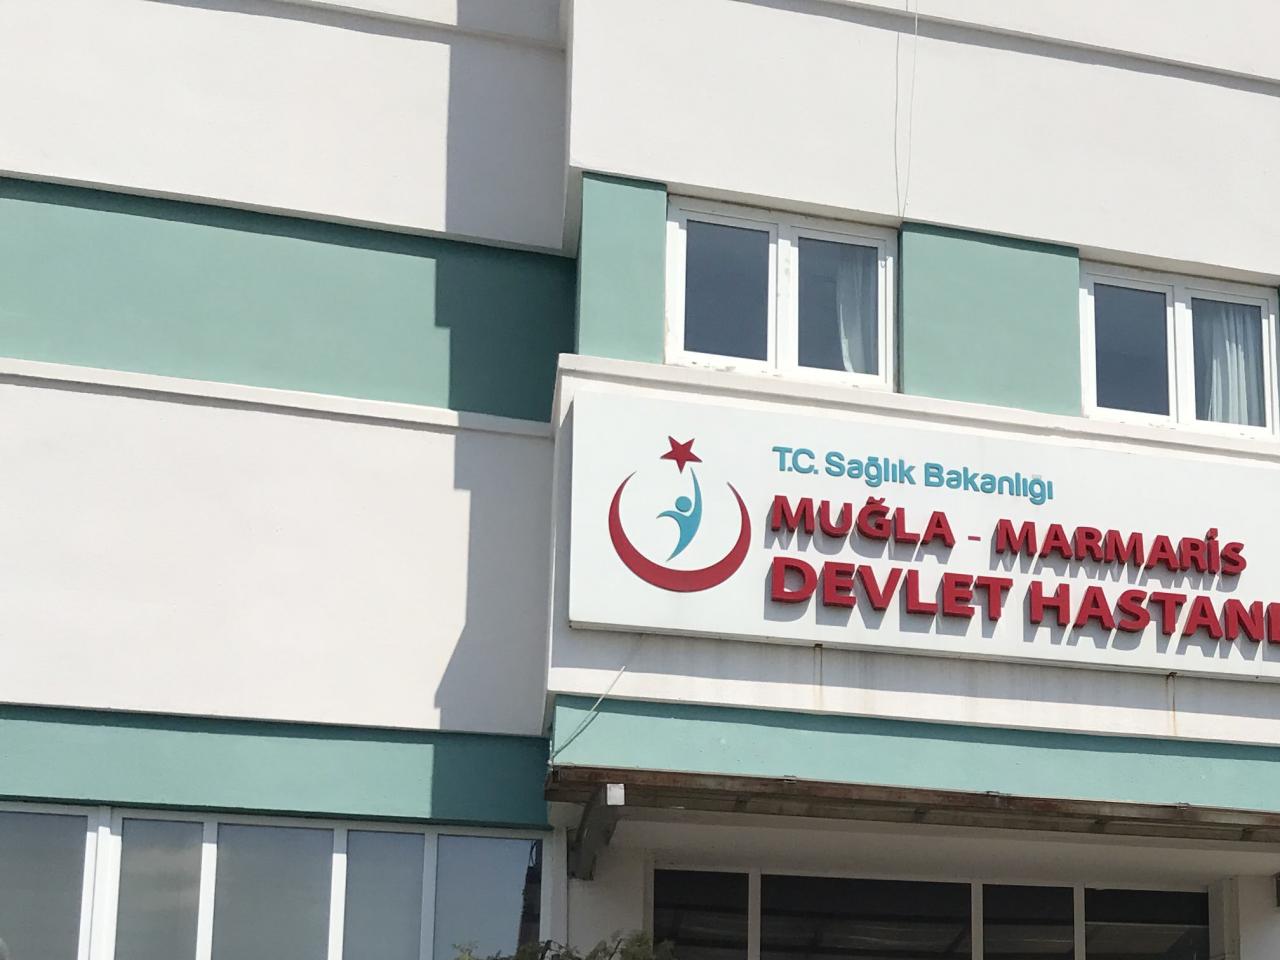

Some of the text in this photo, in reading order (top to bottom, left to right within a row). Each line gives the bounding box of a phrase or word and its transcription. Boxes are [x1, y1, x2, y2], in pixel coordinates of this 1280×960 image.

[772, 446, 1054, 505] T.C. Sağlık Bakanlığı
[771, 495, 956, 548] MUĞLA
[994, 519, 1248, 577] MARMARİS
[771, 556, 1014, 622] DEVLET
